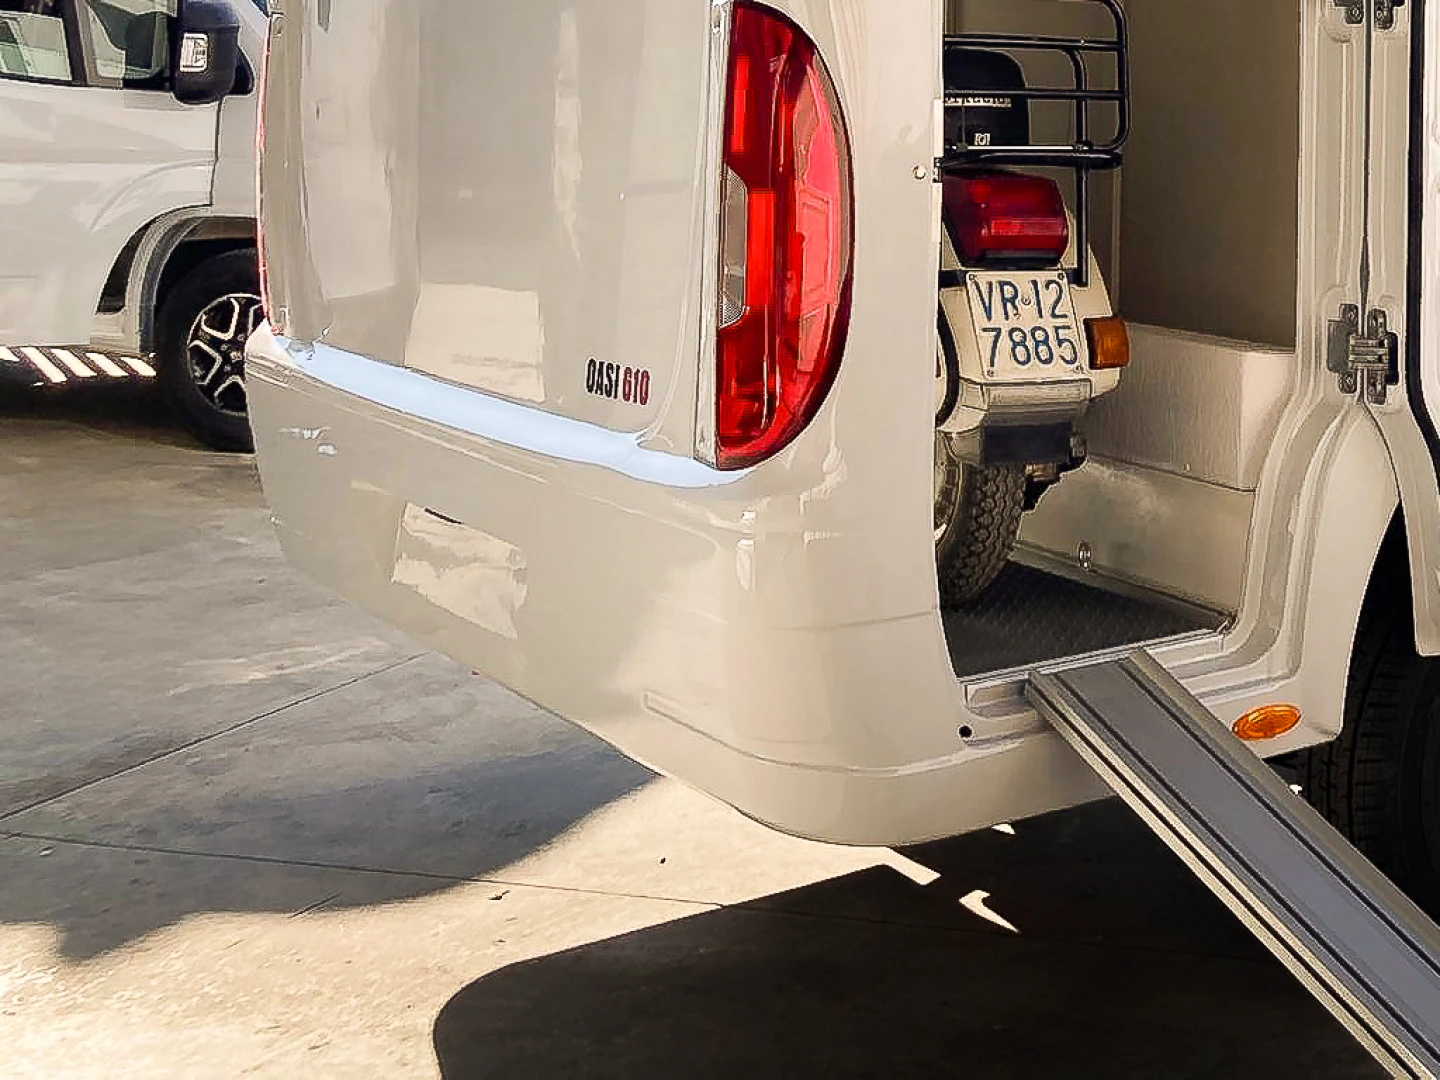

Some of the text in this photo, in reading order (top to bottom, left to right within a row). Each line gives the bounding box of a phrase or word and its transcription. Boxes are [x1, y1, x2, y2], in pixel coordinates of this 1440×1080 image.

[974, 279, 1068, 321] VR 12
[981, 325, 1078, 367] 7885
[586, 358, 650, 405] OASI 610
